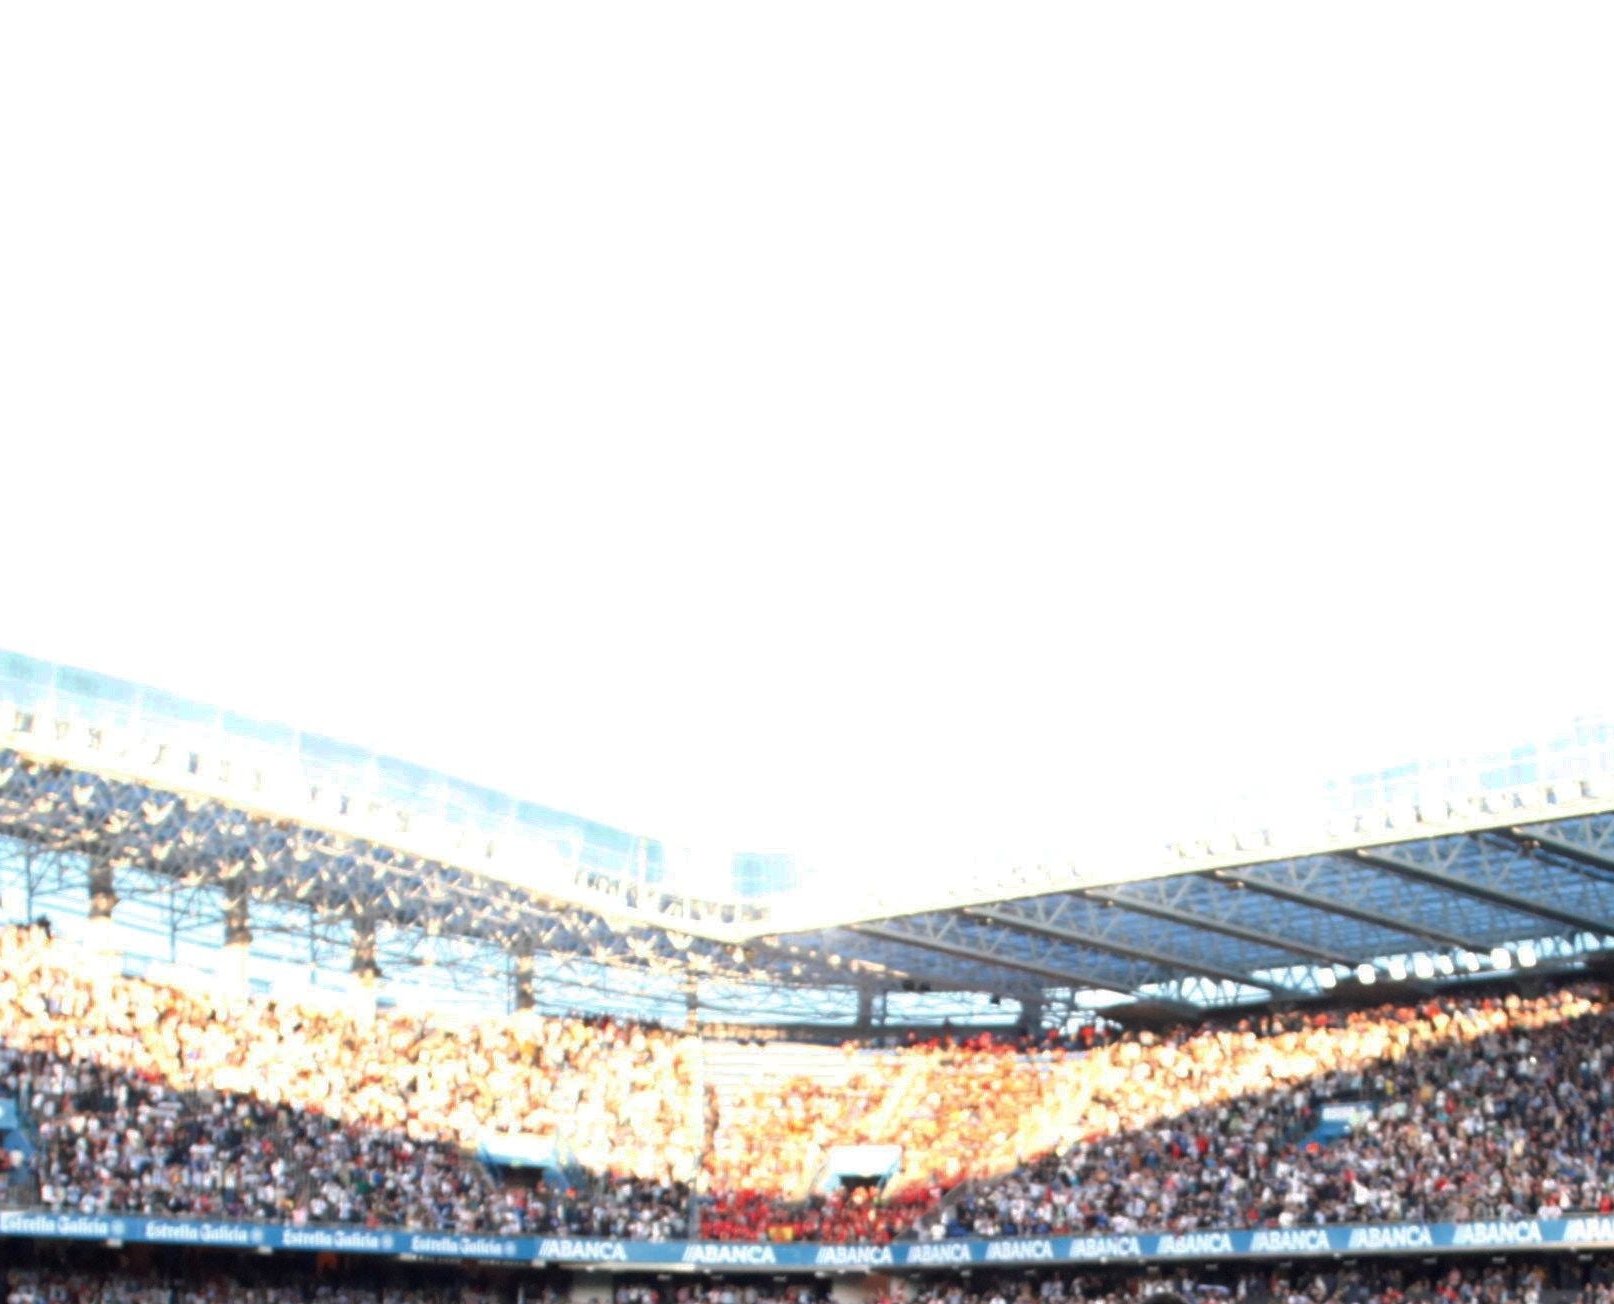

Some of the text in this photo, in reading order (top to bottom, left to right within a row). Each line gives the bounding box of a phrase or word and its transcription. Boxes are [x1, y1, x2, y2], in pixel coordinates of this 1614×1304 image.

[1165, 1231, 1233, 1254] ABANCA
[1259, 1227, 1330, 1252] ABANCA
[1358, 1225, 1432, 1247] ABANCA
[1463, 1221, 1542, 1245] ABANCA
[547, 1241, 627, 1261] ABANCA
[691, 1244, 776, 1264] ABANCA
[823, 1245, 894, 1265] ABANCA
[914, 1243, 972, 1263] ABANCA
[994, 1240, 1053, 1260] ABANCA
[1077, 1236, 1141, 1257] ABANCA
